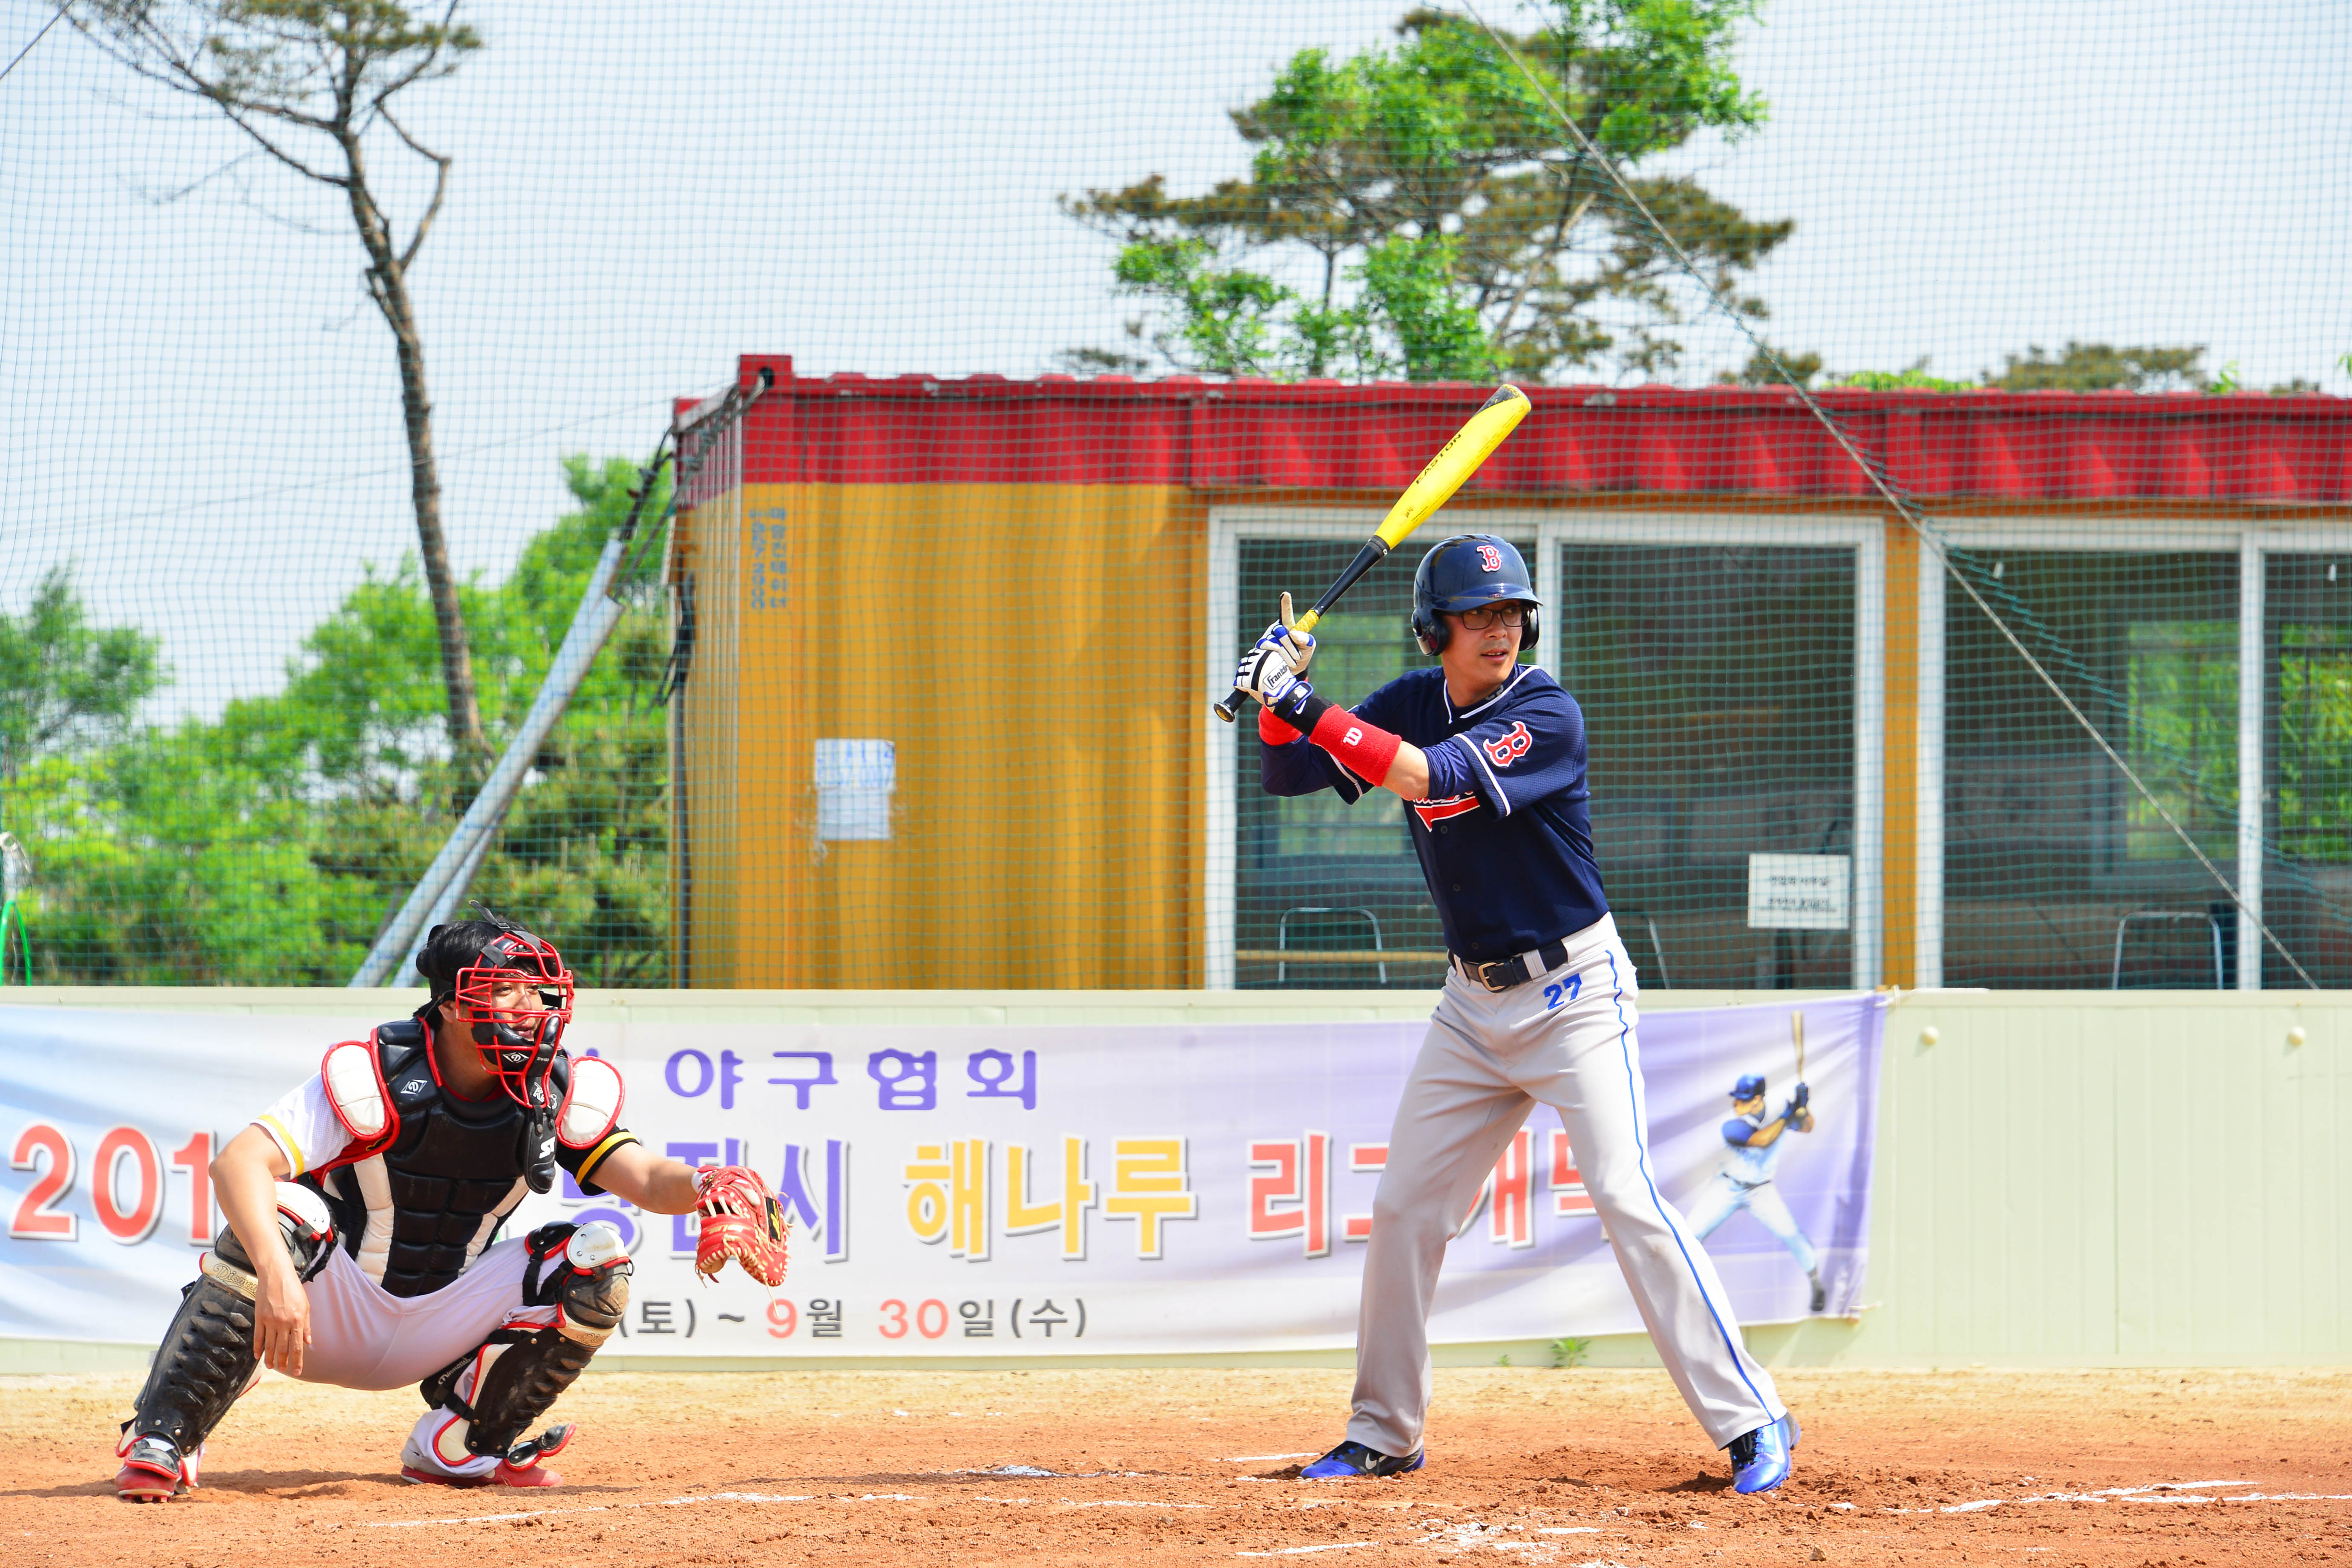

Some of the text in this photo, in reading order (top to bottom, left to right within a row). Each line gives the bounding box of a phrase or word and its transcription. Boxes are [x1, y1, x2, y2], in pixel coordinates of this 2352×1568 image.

[1416, 433, 1461, 484] EASTON
[1476, 545, 1502, 572] B
[1483, 721, 1533, 767] B
[1543, 973, 1582, 1011] 27
[664, 1048, 1037, 1110] 야구협회
[9, 1121, 219, 1246] 201
[902, 1136, 1196, 1262] 해나루
[766, 1298, 842, 1339] 9월
